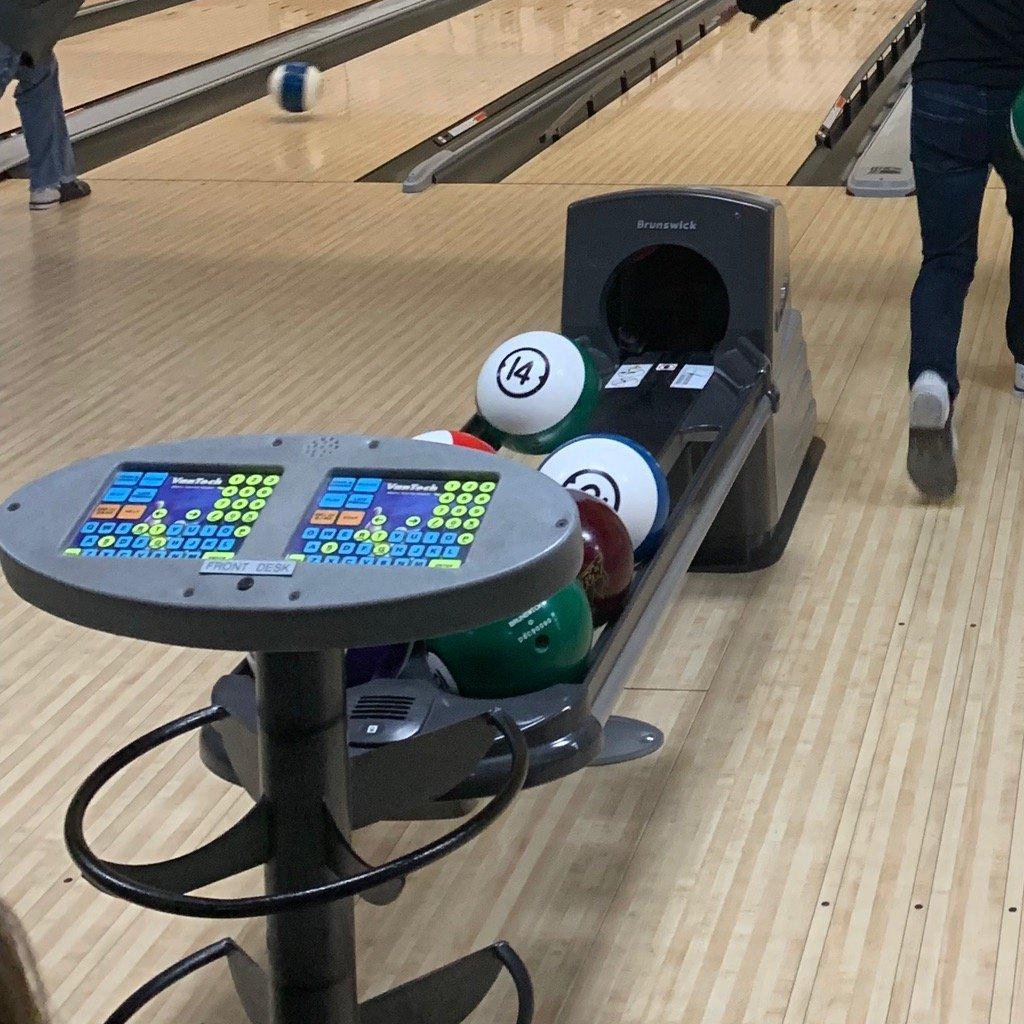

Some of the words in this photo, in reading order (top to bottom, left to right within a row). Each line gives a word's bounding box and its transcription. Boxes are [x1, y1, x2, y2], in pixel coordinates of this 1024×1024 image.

[637, 219, 698, 230] Brunswick
[506, 356, 535, 385] 14
[205, 562, 249, 572] FRONT
[256, 563, 290, 573] DESK
